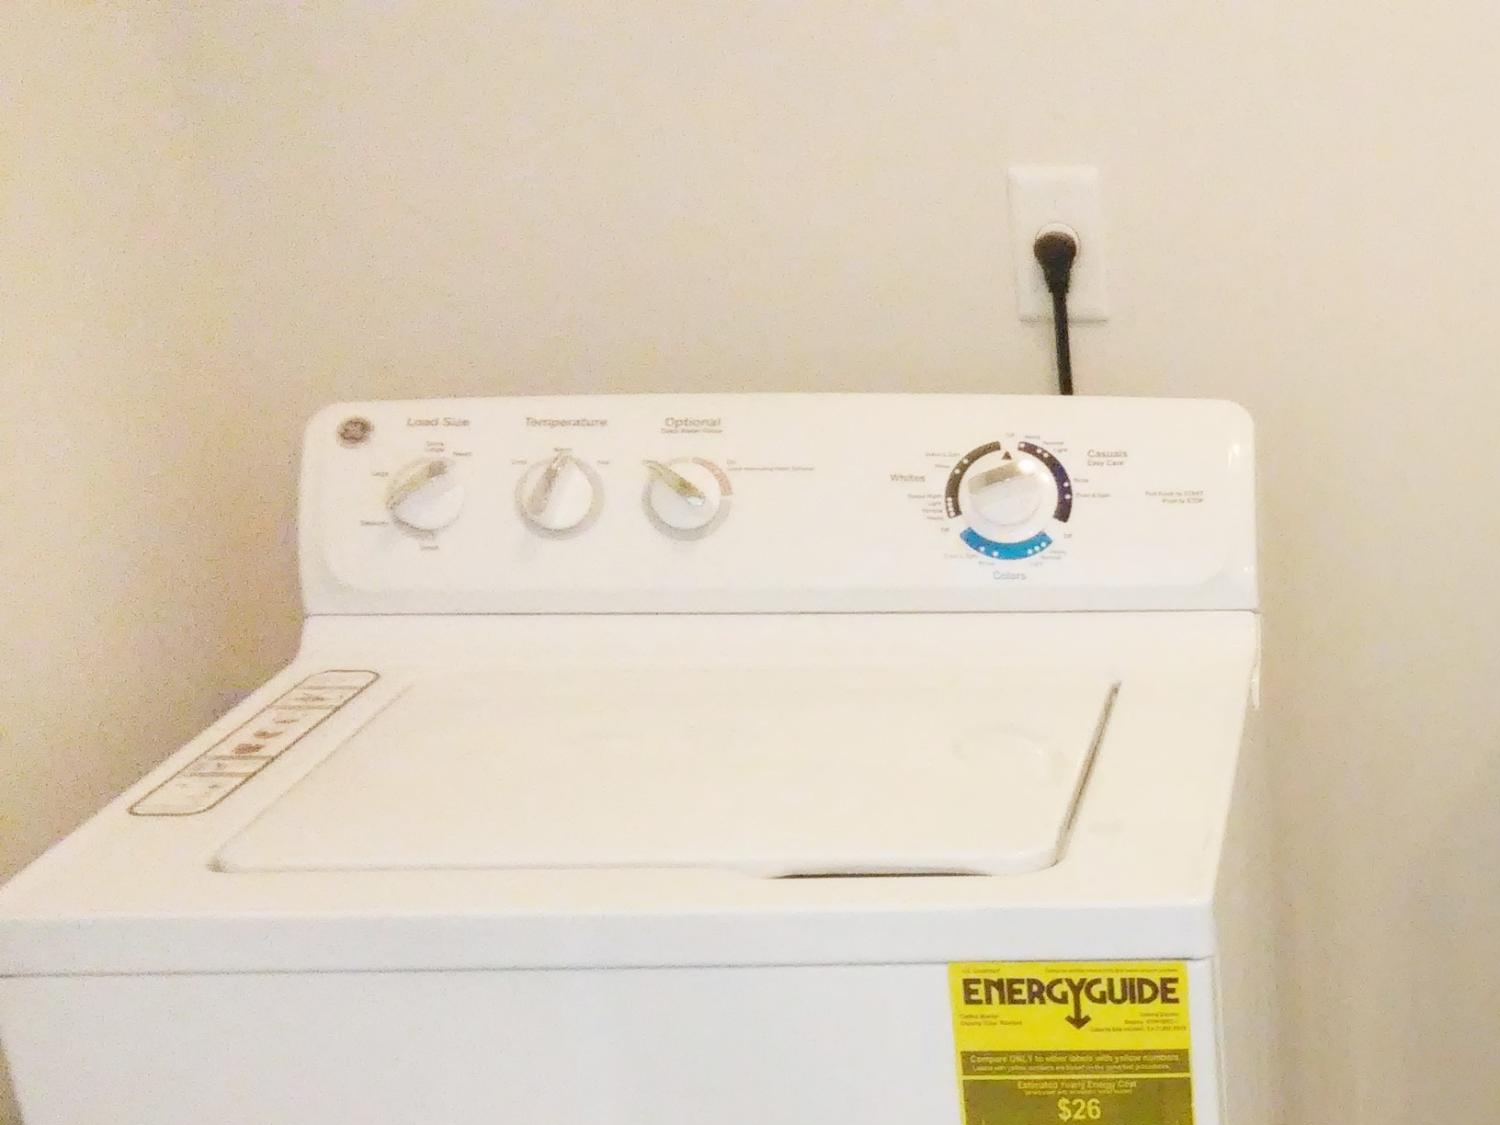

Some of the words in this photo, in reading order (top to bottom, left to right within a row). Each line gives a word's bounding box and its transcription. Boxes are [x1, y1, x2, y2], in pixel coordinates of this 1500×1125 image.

[406, 416, 438, 427] Load
[441, 416, 470, 427] Size
[525, 416, 609, 429] Temperature
[664, 416, 722, 429] Optional
[992, 569, 1028, 581] Colors
[961, 976, 1181, 1007] ENERGYGUIDE
[1057, 1097, 1101, 1122] $26
